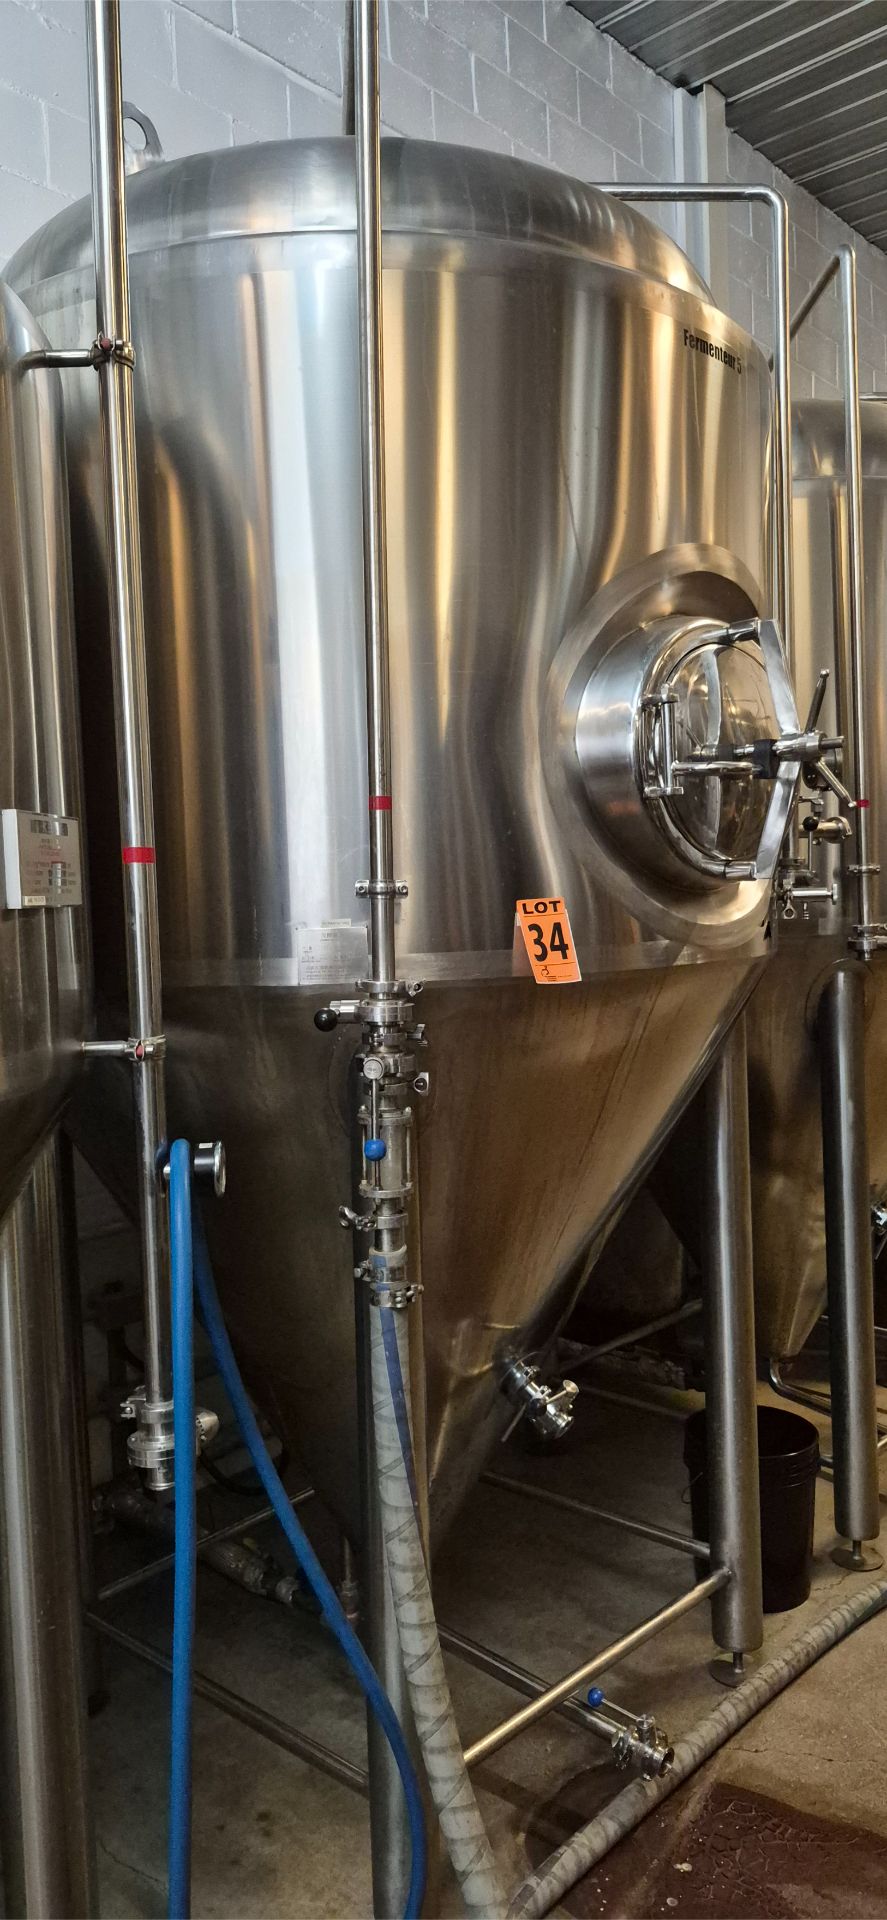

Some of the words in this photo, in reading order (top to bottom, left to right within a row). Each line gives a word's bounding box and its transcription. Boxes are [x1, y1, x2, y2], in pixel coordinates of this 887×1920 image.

[683, 328, 736, 370] Fermenteur
[736, 356, 742, 374] 5
[522, 900, 561, 914] LOT
[527, 922, 569, 962] 34
